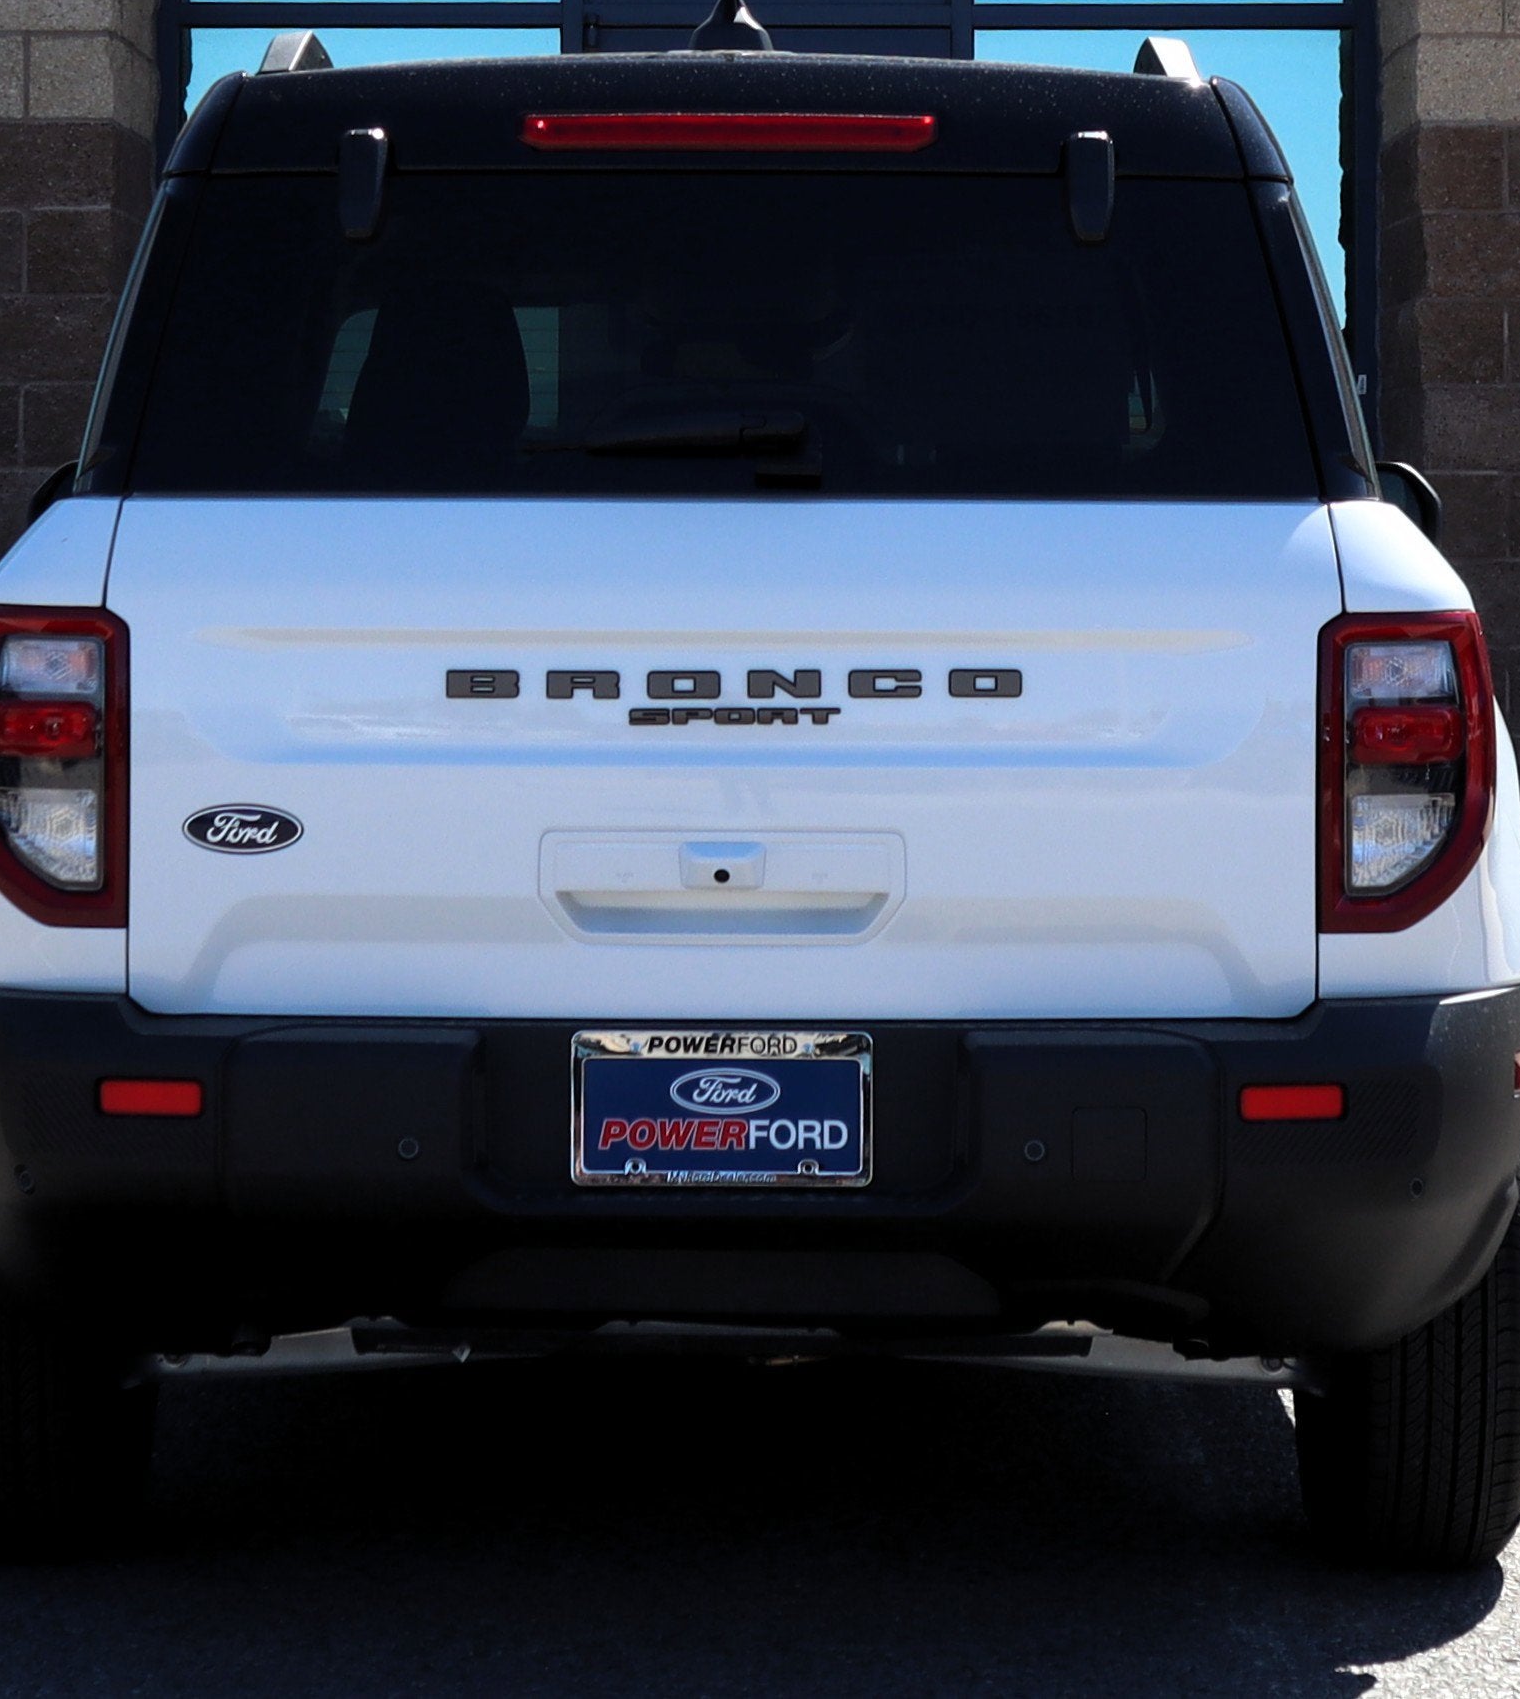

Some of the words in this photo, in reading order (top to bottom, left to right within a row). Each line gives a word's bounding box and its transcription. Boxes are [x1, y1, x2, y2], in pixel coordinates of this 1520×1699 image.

[445, 669, 1023, 699] BRONCO
[628, 707, 841, 726] SPORT
[206, 812, 279, 844] Ford
[646, 1036, 798, 1054] POWERFORD
[692, 1076, 757, 1104] Ford
[597, 1118, 849, 1151] POWERFORD
